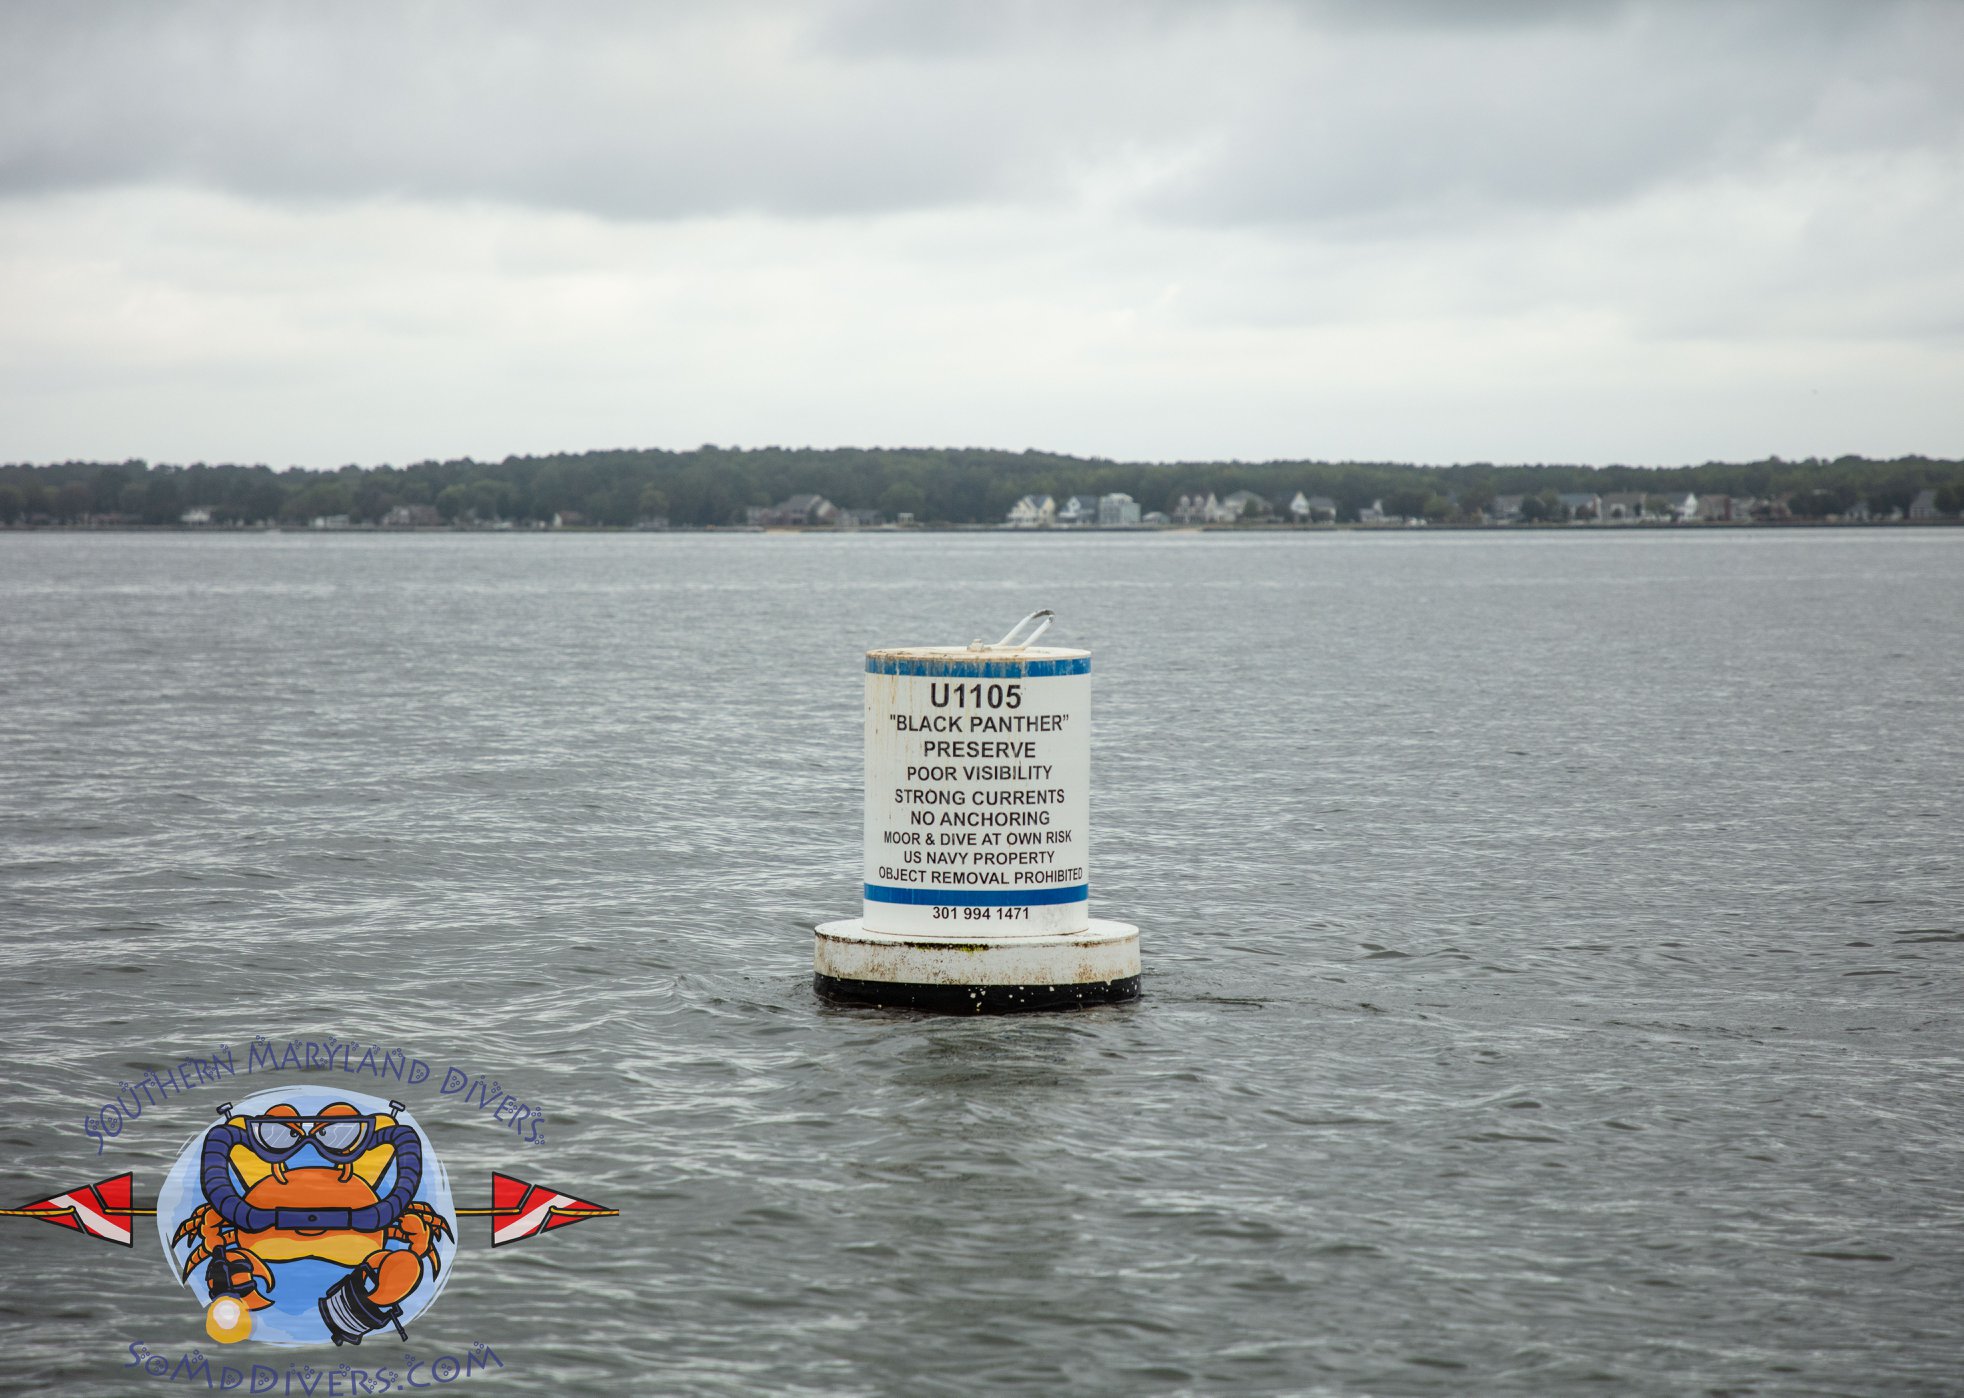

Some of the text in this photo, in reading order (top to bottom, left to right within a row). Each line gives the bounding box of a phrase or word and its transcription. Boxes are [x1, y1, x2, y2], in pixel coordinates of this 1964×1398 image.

[931, 683, 1022, 709] U1105
[924, 741, 1035, 758] PRESERVE
[908, 765, 1052, 781] POOR VISIBILITY
[895, 789, 1064, 805] STRONG CURRENTS
[911, 811, 1049, 826] NO ANCHORING
[884, 830, 1071, 845] MOOR & DIVE AT OWN RISK
[904, 851, 1054, 865] US NAVY PROPERTY
[879, 866, 1082, 884] OBJECT REMOVAL PROHIBITED
[933, 906, 1028, 920] 301 994 1471
